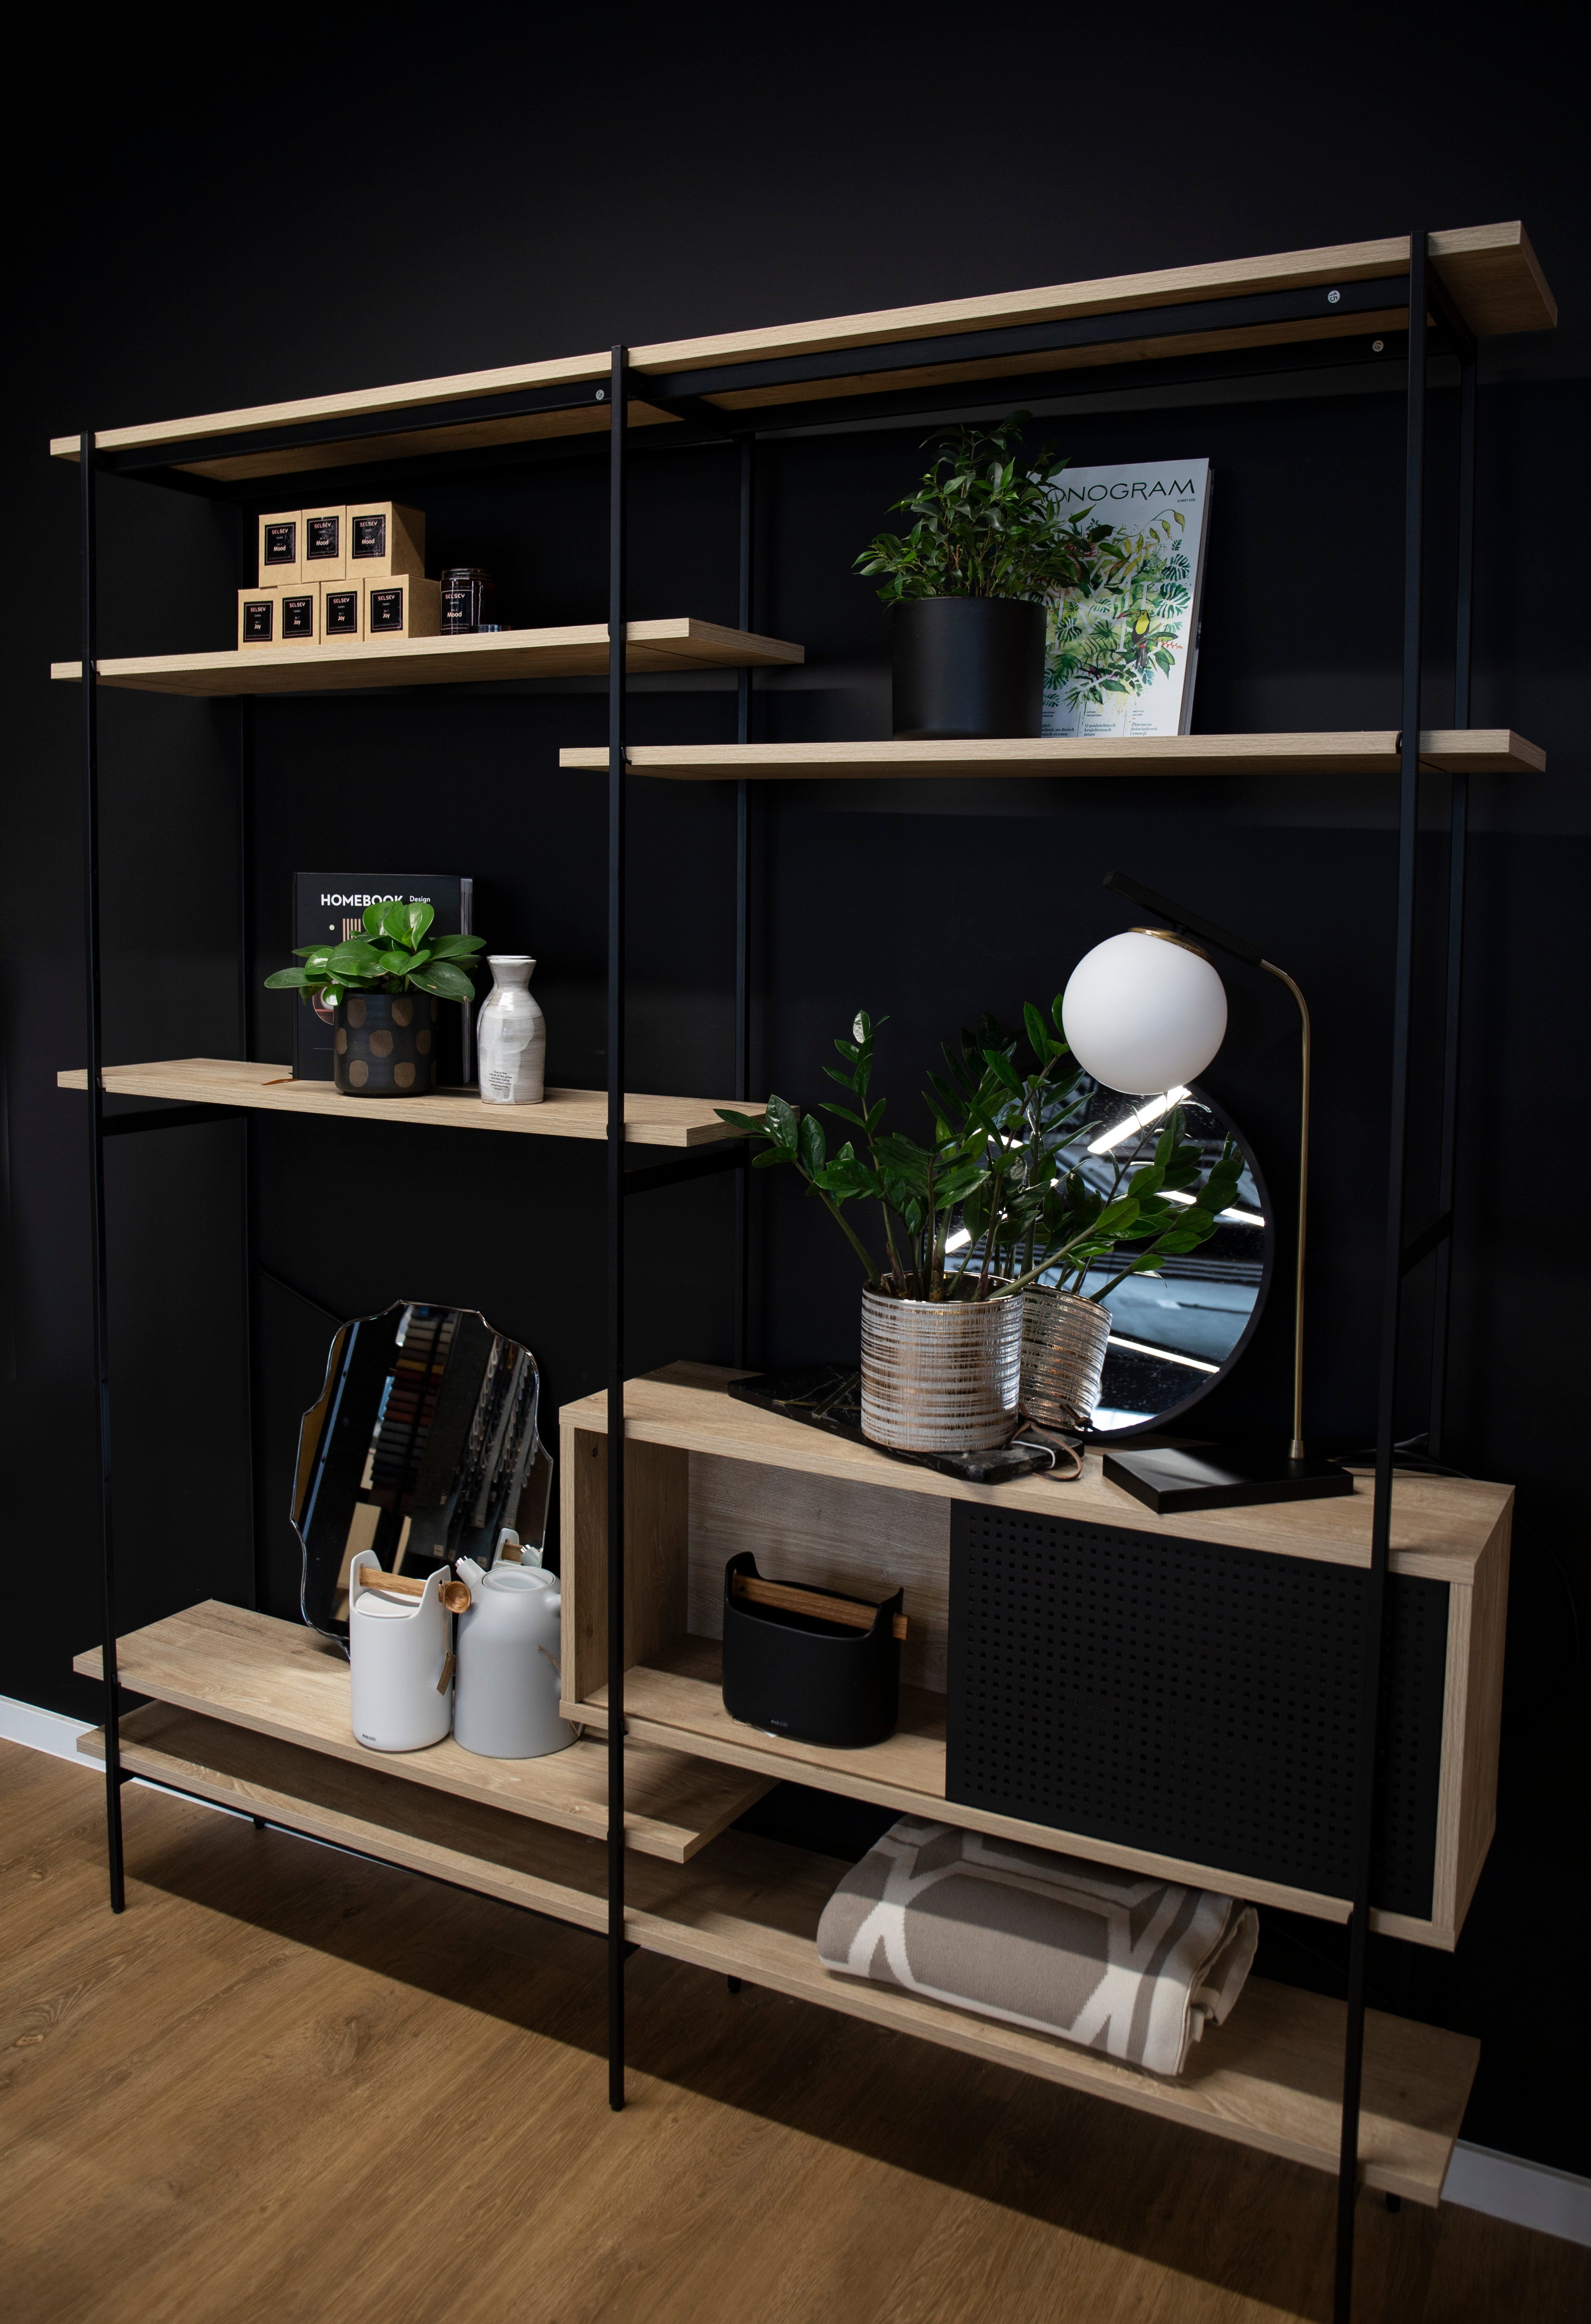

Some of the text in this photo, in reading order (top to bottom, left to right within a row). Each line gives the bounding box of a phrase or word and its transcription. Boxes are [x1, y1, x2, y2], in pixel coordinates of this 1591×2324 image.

[1330, 292, 1338, 302] 15
[1374, 342, 1381, 350] 15
[1045, 479, 1195, 504] ONOGRAM
